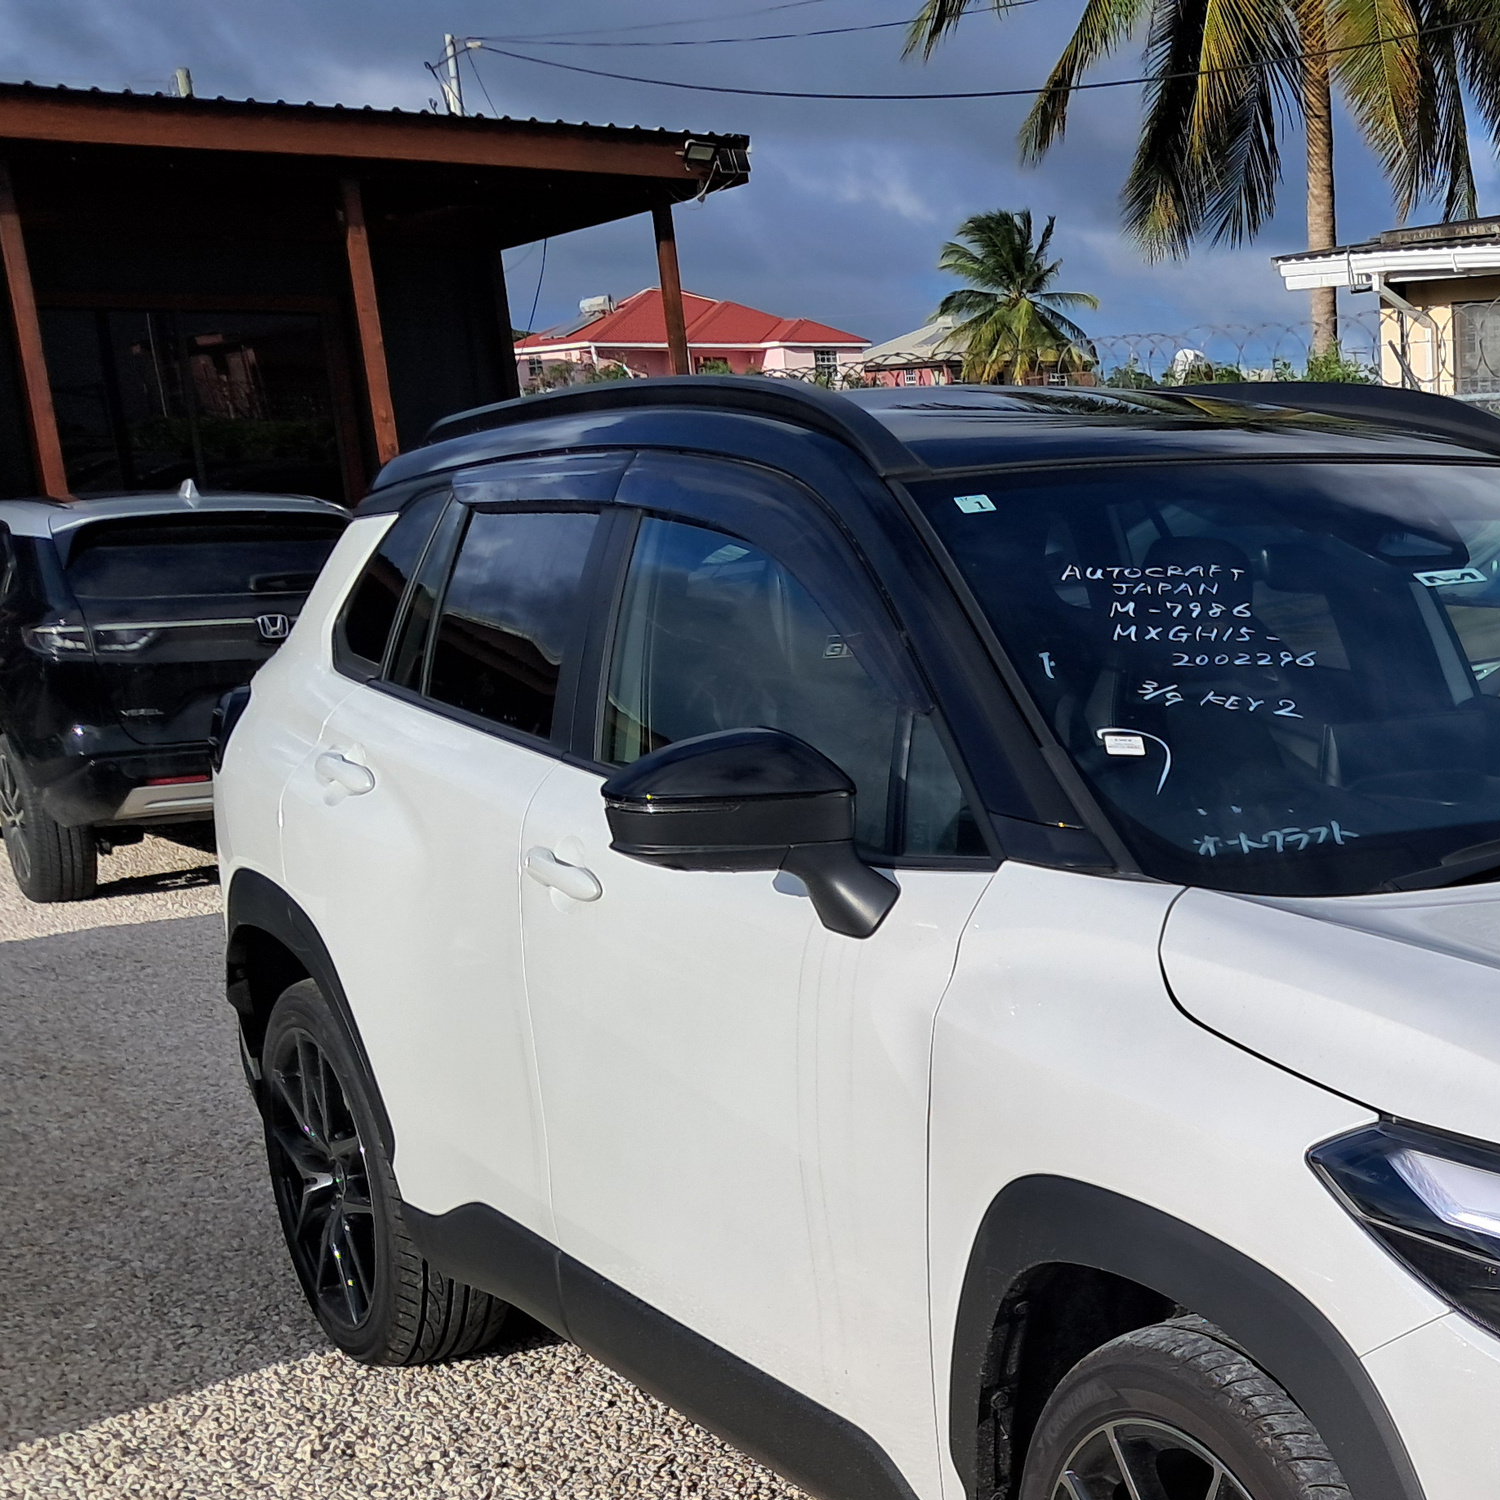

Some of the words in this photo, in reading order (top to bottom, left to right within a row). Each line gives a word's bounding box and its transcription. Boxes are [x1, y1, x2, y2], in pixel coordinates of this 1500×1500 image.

[1061, 564, 1245, 581] AUTOCRAFT
[1112, 582, 1219, 597] JAPAN
[1200, 690, 1264, 712] KEY
[1273, 699, 1304, 719] 2
